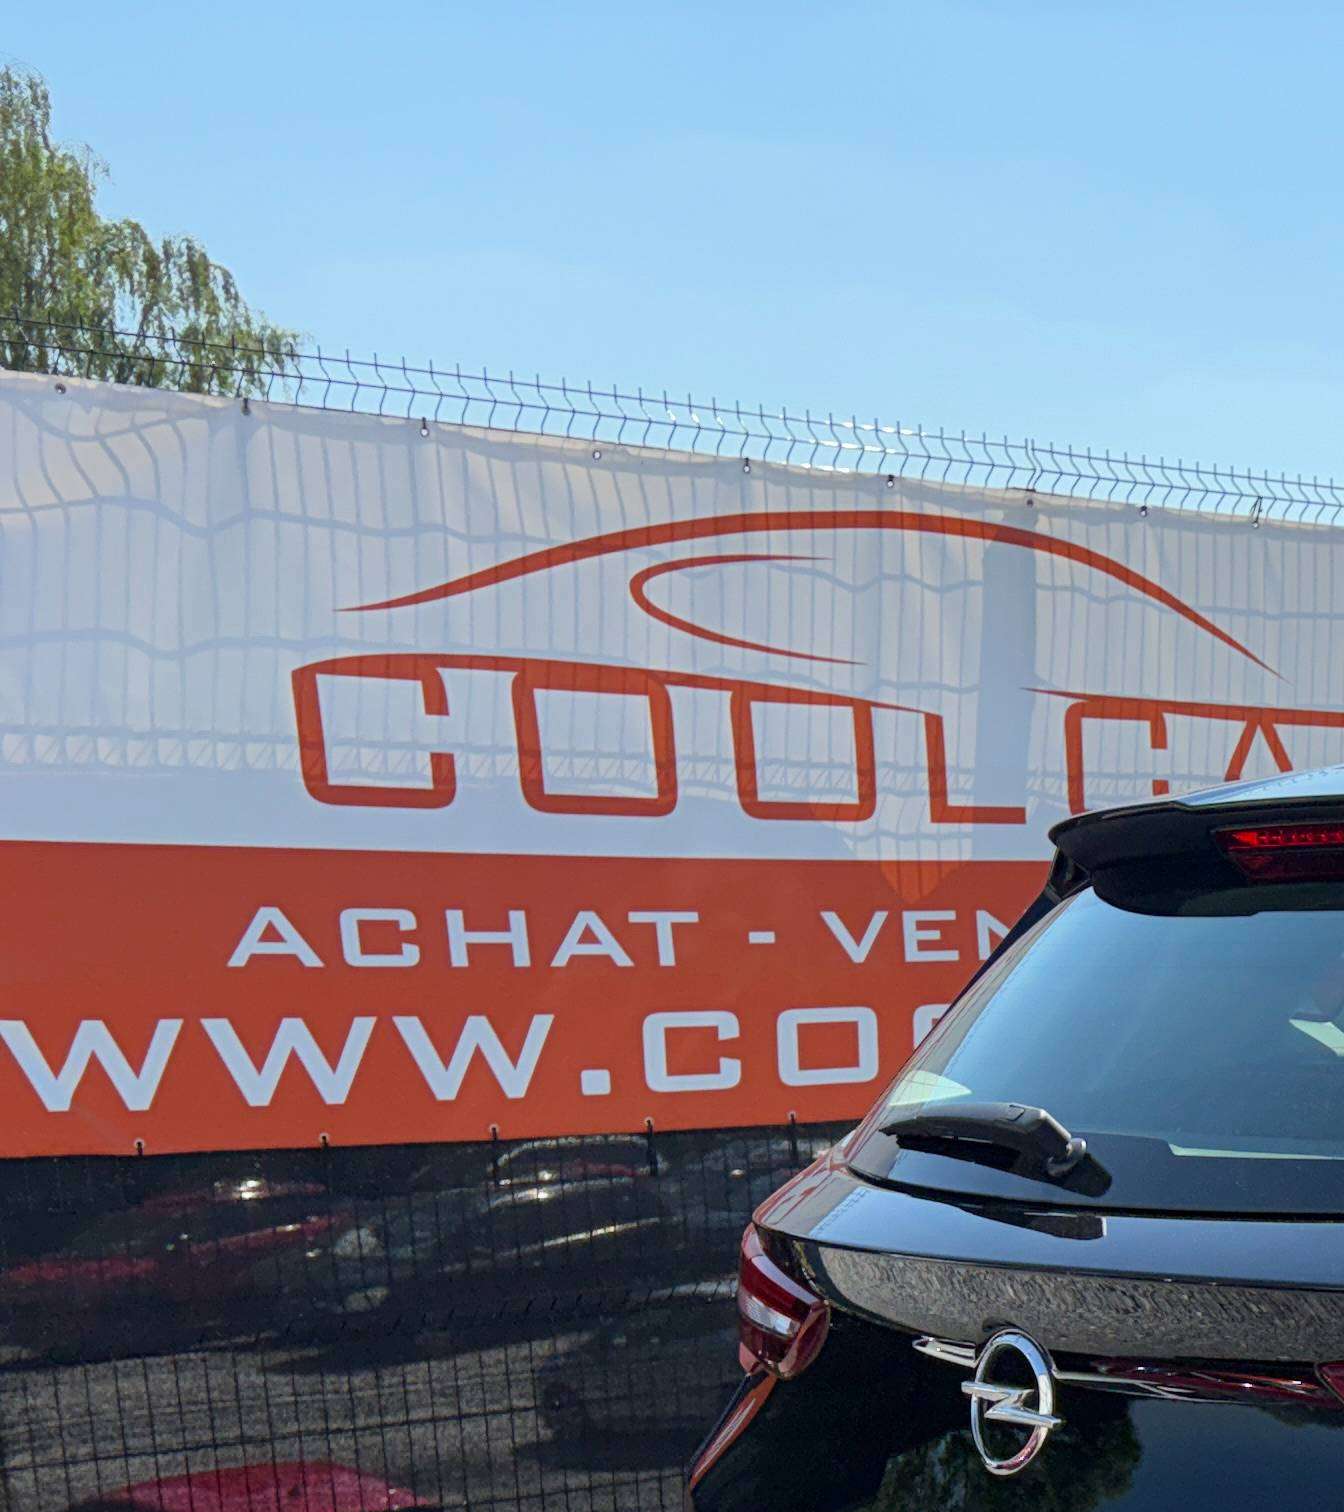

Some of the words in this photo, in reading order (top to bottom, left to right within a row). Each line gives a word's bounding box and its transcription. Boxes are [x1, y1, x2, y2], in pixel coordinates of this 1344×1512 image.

[291, 653, 1027, 824] COOL
[226, 905, 699, 968] ACHAT
[0, 1003, 952, 1113] WWW.CO
